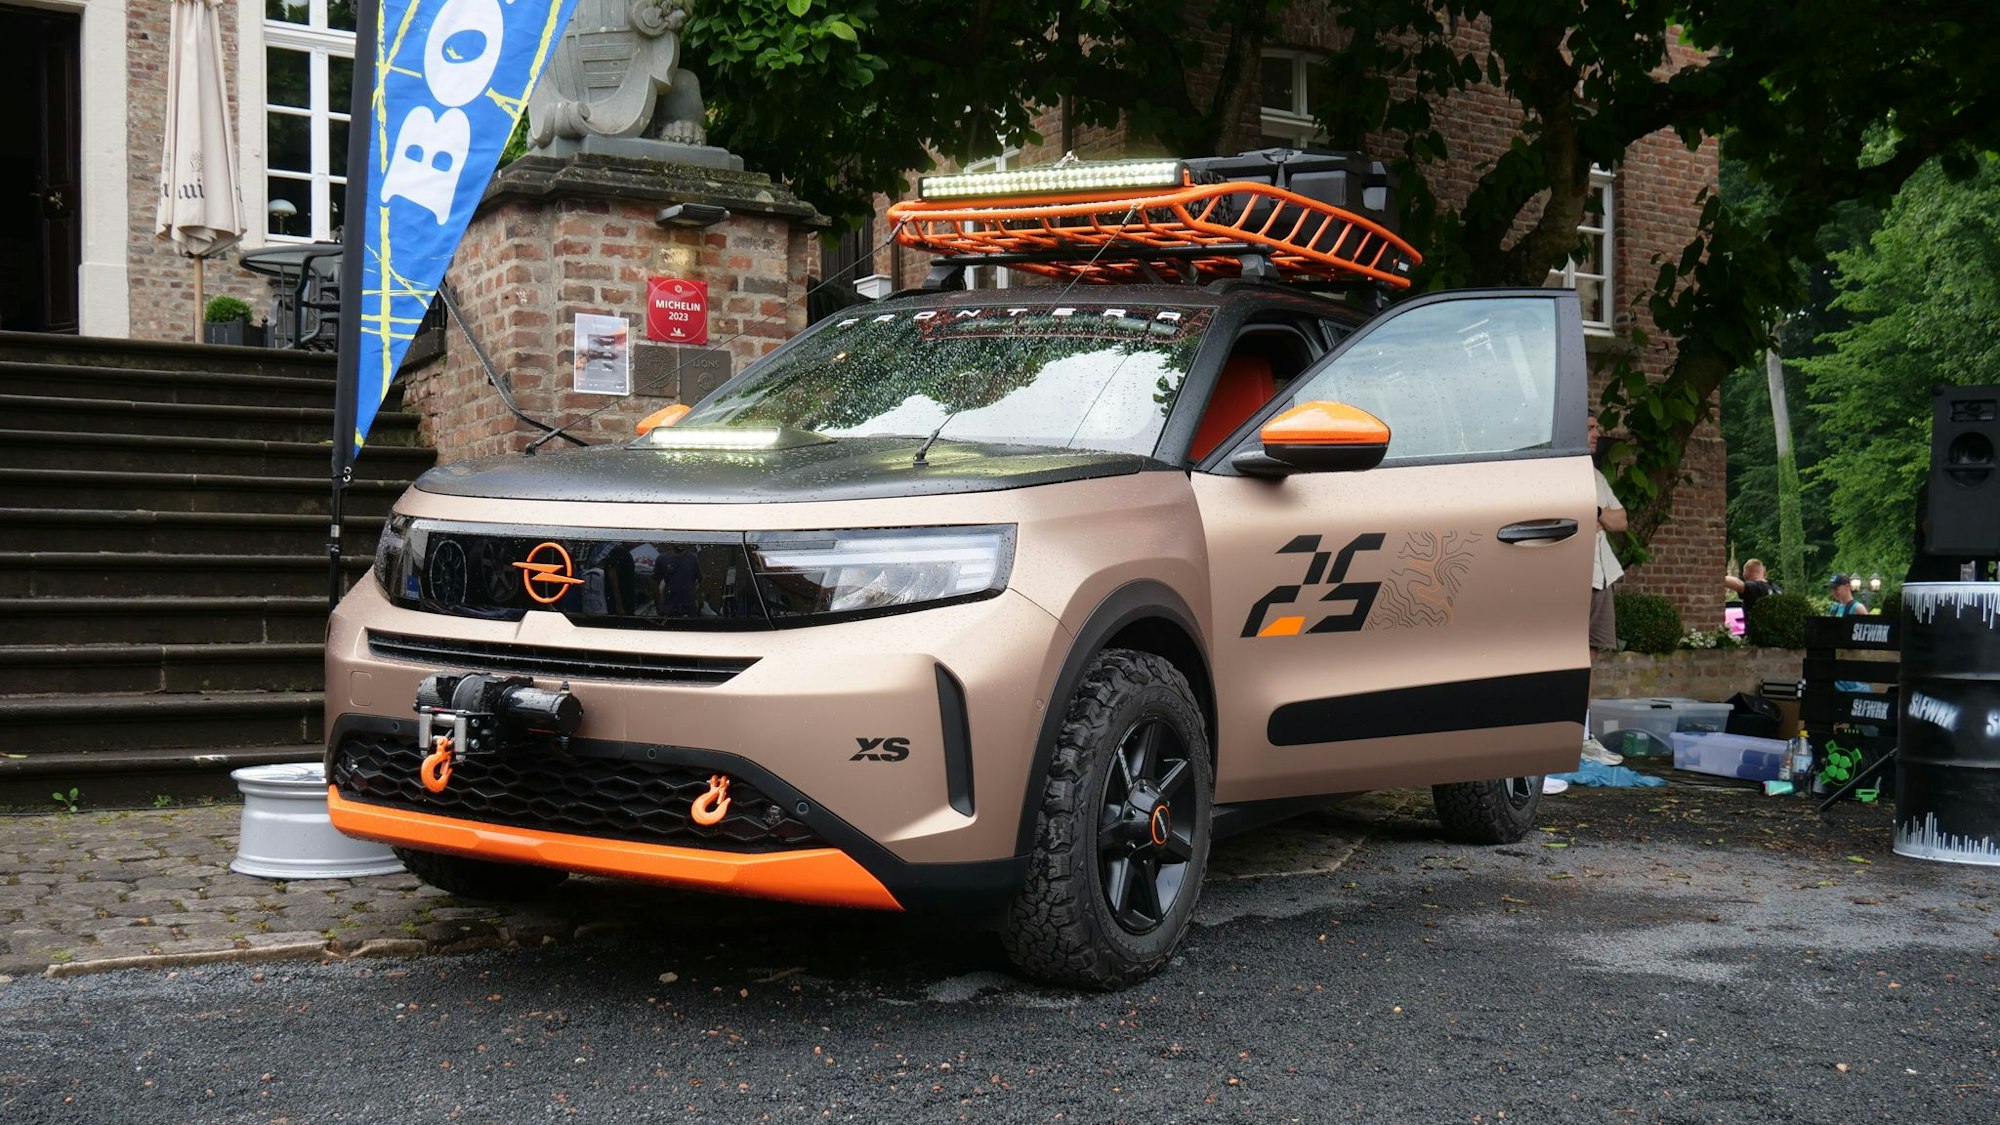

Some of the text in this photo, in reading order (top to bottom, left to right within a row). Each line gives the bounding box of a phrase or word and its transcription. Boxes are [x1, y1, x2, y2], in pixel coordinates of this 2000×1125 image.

[655, 300, 701, 311] MICHELIN
[668, 311, 689, 321] 2023
[837, 308, 1182, 327] FRONTERA
[1240, 532, 1387, 638] 25
[1852, 623, 1890, 642] SLFWRK
[1851, 699, 1889, 719] SLFWRK
[849, 737, 910, 762] XS
